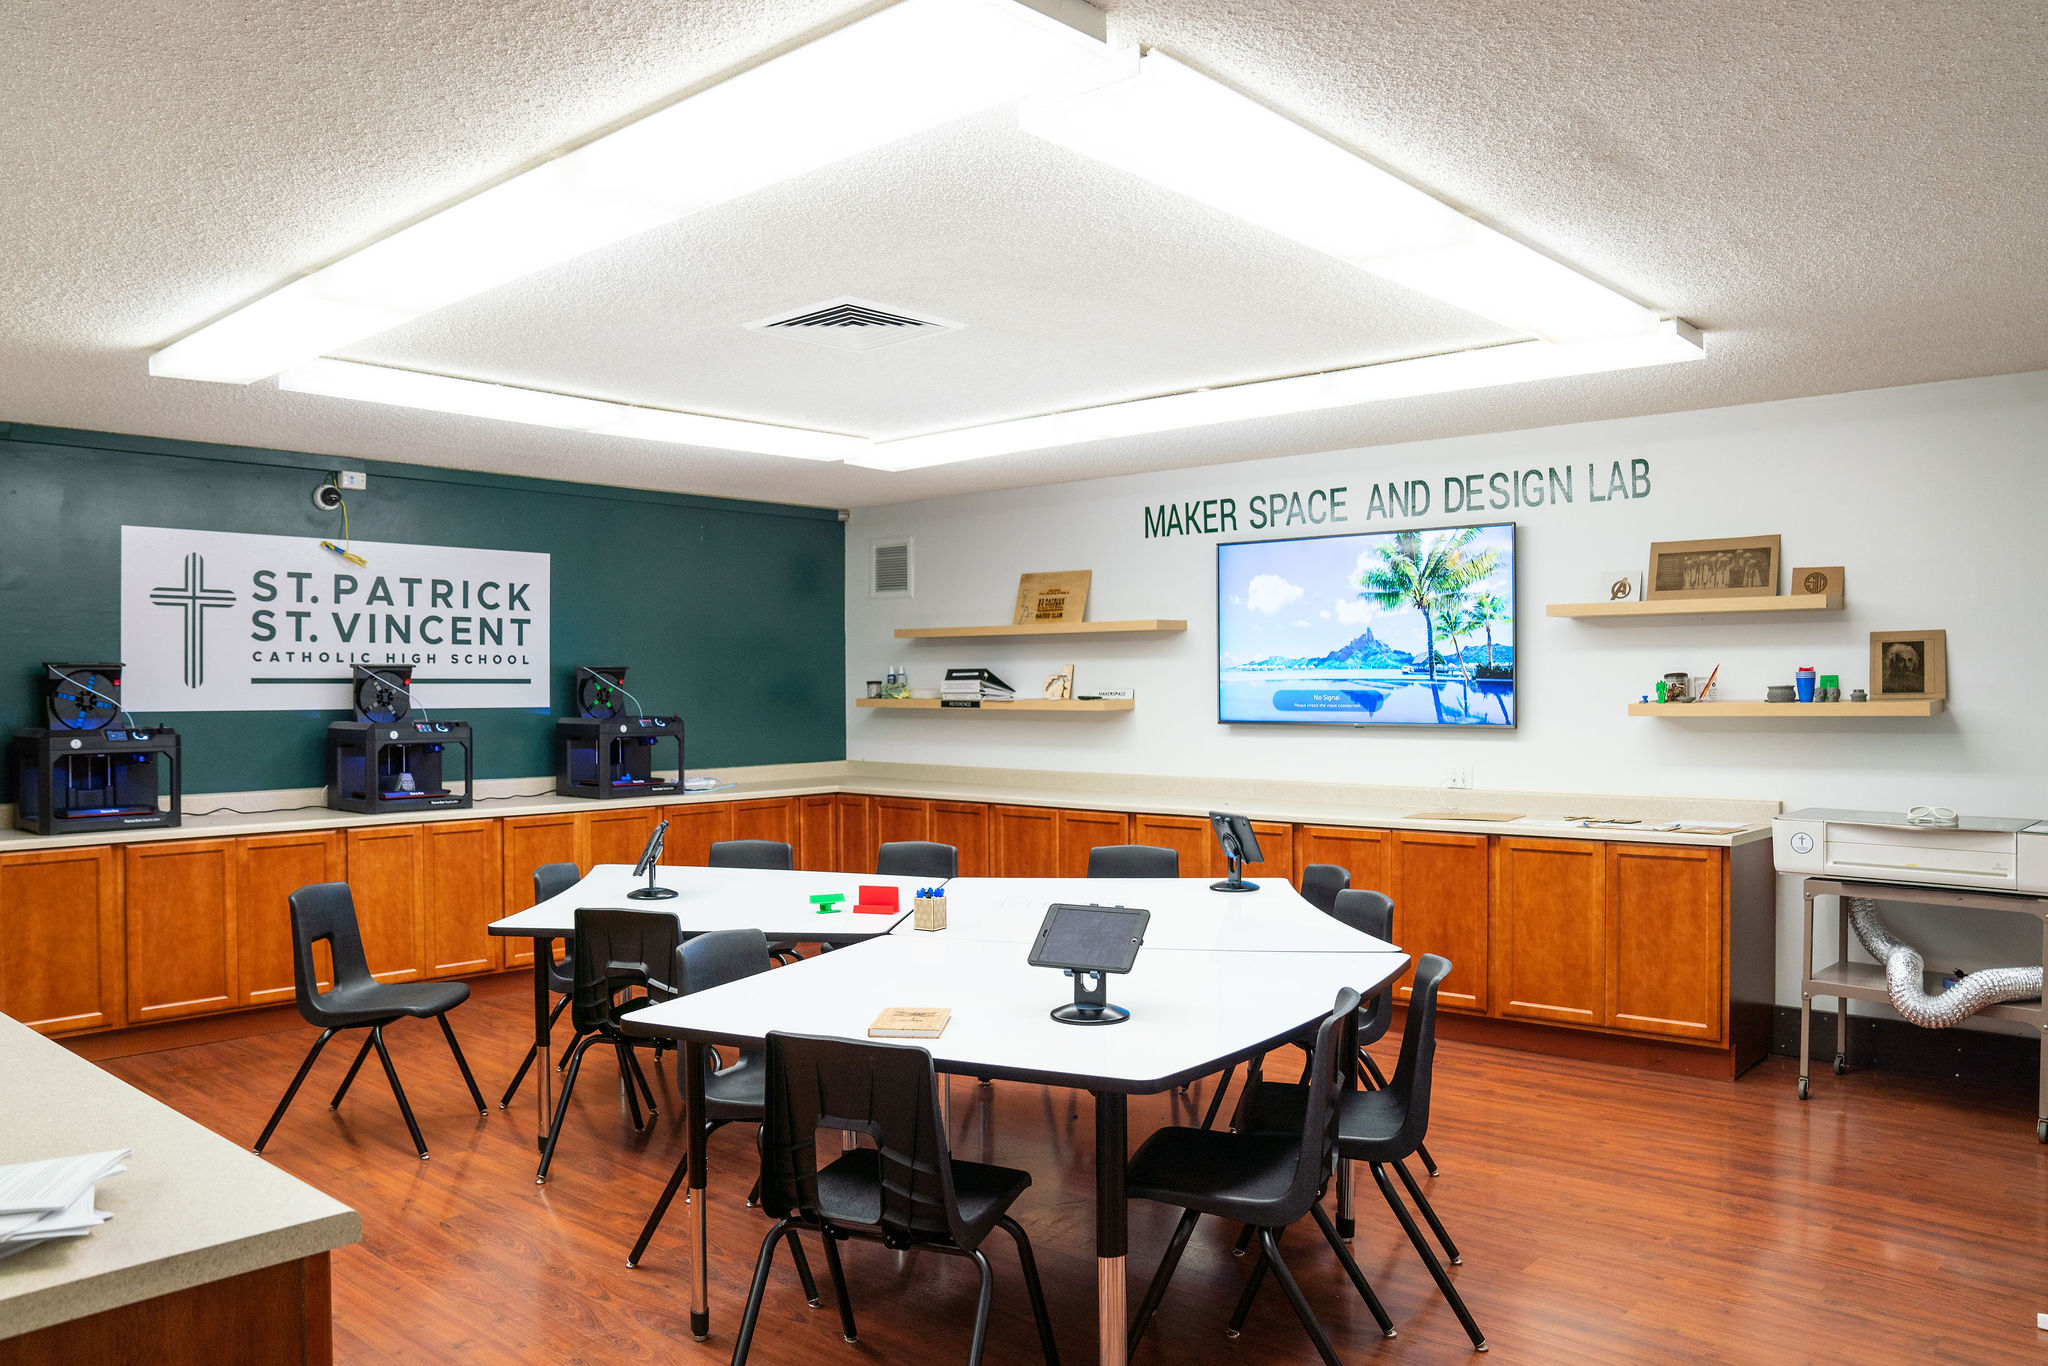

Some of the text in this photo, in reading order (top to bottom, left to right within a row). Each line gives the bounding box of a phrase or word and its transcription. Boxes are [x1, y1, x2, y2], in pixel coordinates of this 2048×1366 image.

[1145, 459, 1652, 539] MAKER SPACE AND DESIGN LAB
[252, 569, 530, 612] ST. PATRICK
[252, 609, 530, 647] ST. VINCENT
[252, 651, 530, 665] CATHOLIC HIGH SCHOOL
